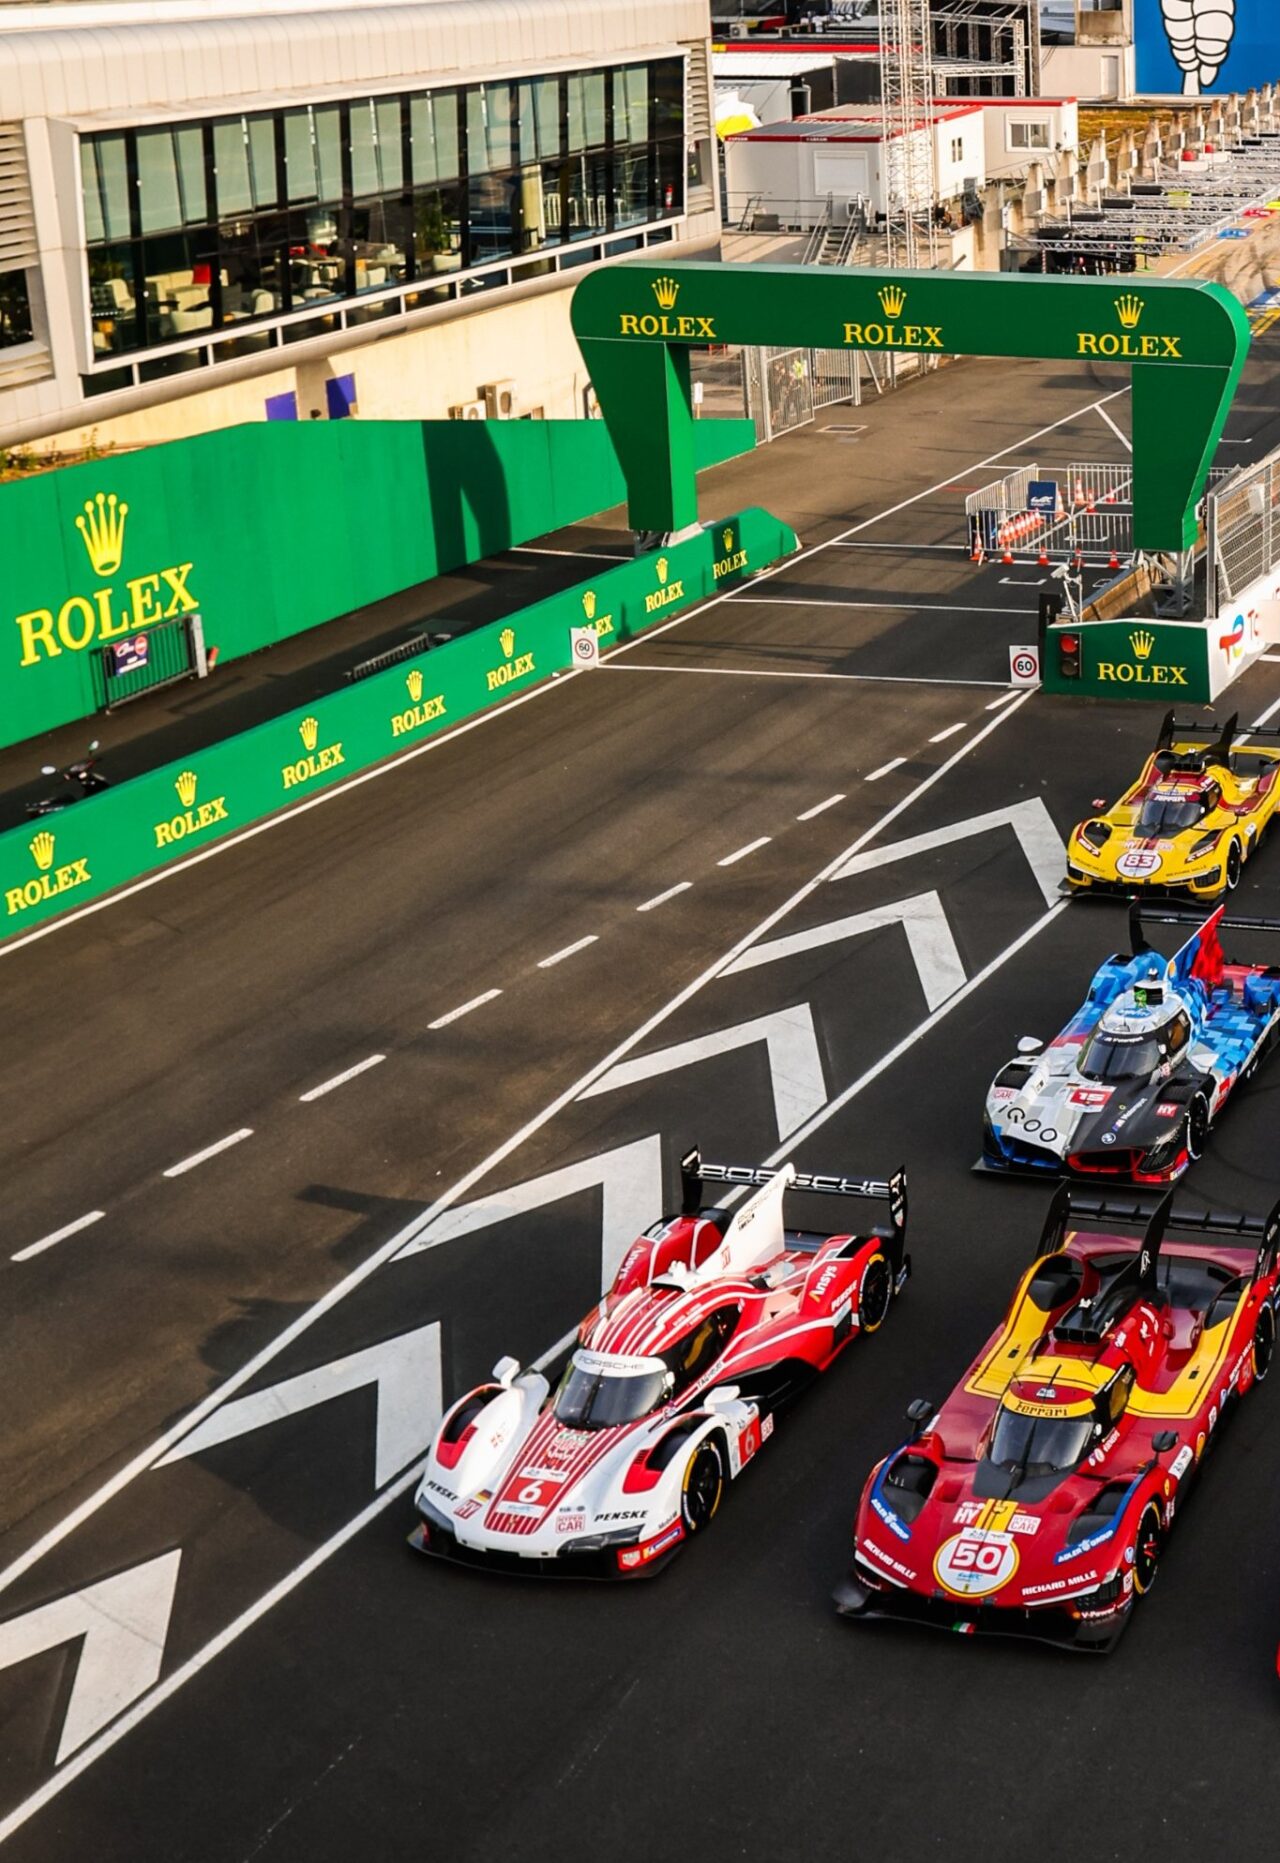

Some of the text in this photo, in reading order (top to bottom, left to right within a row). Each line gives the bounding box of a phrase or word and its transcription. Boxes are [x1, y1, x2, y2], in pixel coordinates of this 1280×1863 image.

[620, 314, 716, 338] ROLEX
[844, 323, 943, 348] ROLEX
[1077, 333, 1183, 358] ROLEX
[713, 550, 748, 579] ROLEX
[645, 581, 684, 612] ROLEX
[16, 564, 199, 666] ROLEX
[487, 653, 535, 691] ROLEX
[1017, 661, 1033, 672] 60
[1097, 663, 1188, 685] ROLEX
[392, 696, 446, 737] ROLEX
[282, 744, 345, 789] ROLEX
[154, 797, 228, 847] ROLEX
[1126, 855, 1154, 867] 83
[6, 859, 91, 914] ROLEX
[1078, 1090, 1106, 1102] 15
[1158, 1104, 1176, 1115] HY
[698, 1164, 890, 1194] PORSCHE
[809, 1264, 838, 1303] Ansys
[579, 1355, 646, 1370] PORSCHE
[1015, 1400, 1068, 1417] Ferrari
[426, 1480, 459, 1501] PENSKE
[517, 1480, 543, 1503] 6
[558, 1521, 583, 1531] CAR
[594, 1510, 648, 1522] PENSKE
[953, 1507, 980, 1524] HY
[1011, 1521, 1037, 1533] CAR
[952, 1542, 1002, 1571] 50
[1058, 1529, 1114, 1563] ADLER GROUP
[863, 1539, 917, 1580] RICHARD MILLE
[1022, 1570, 1098, 1596] RICHARD MILLE
